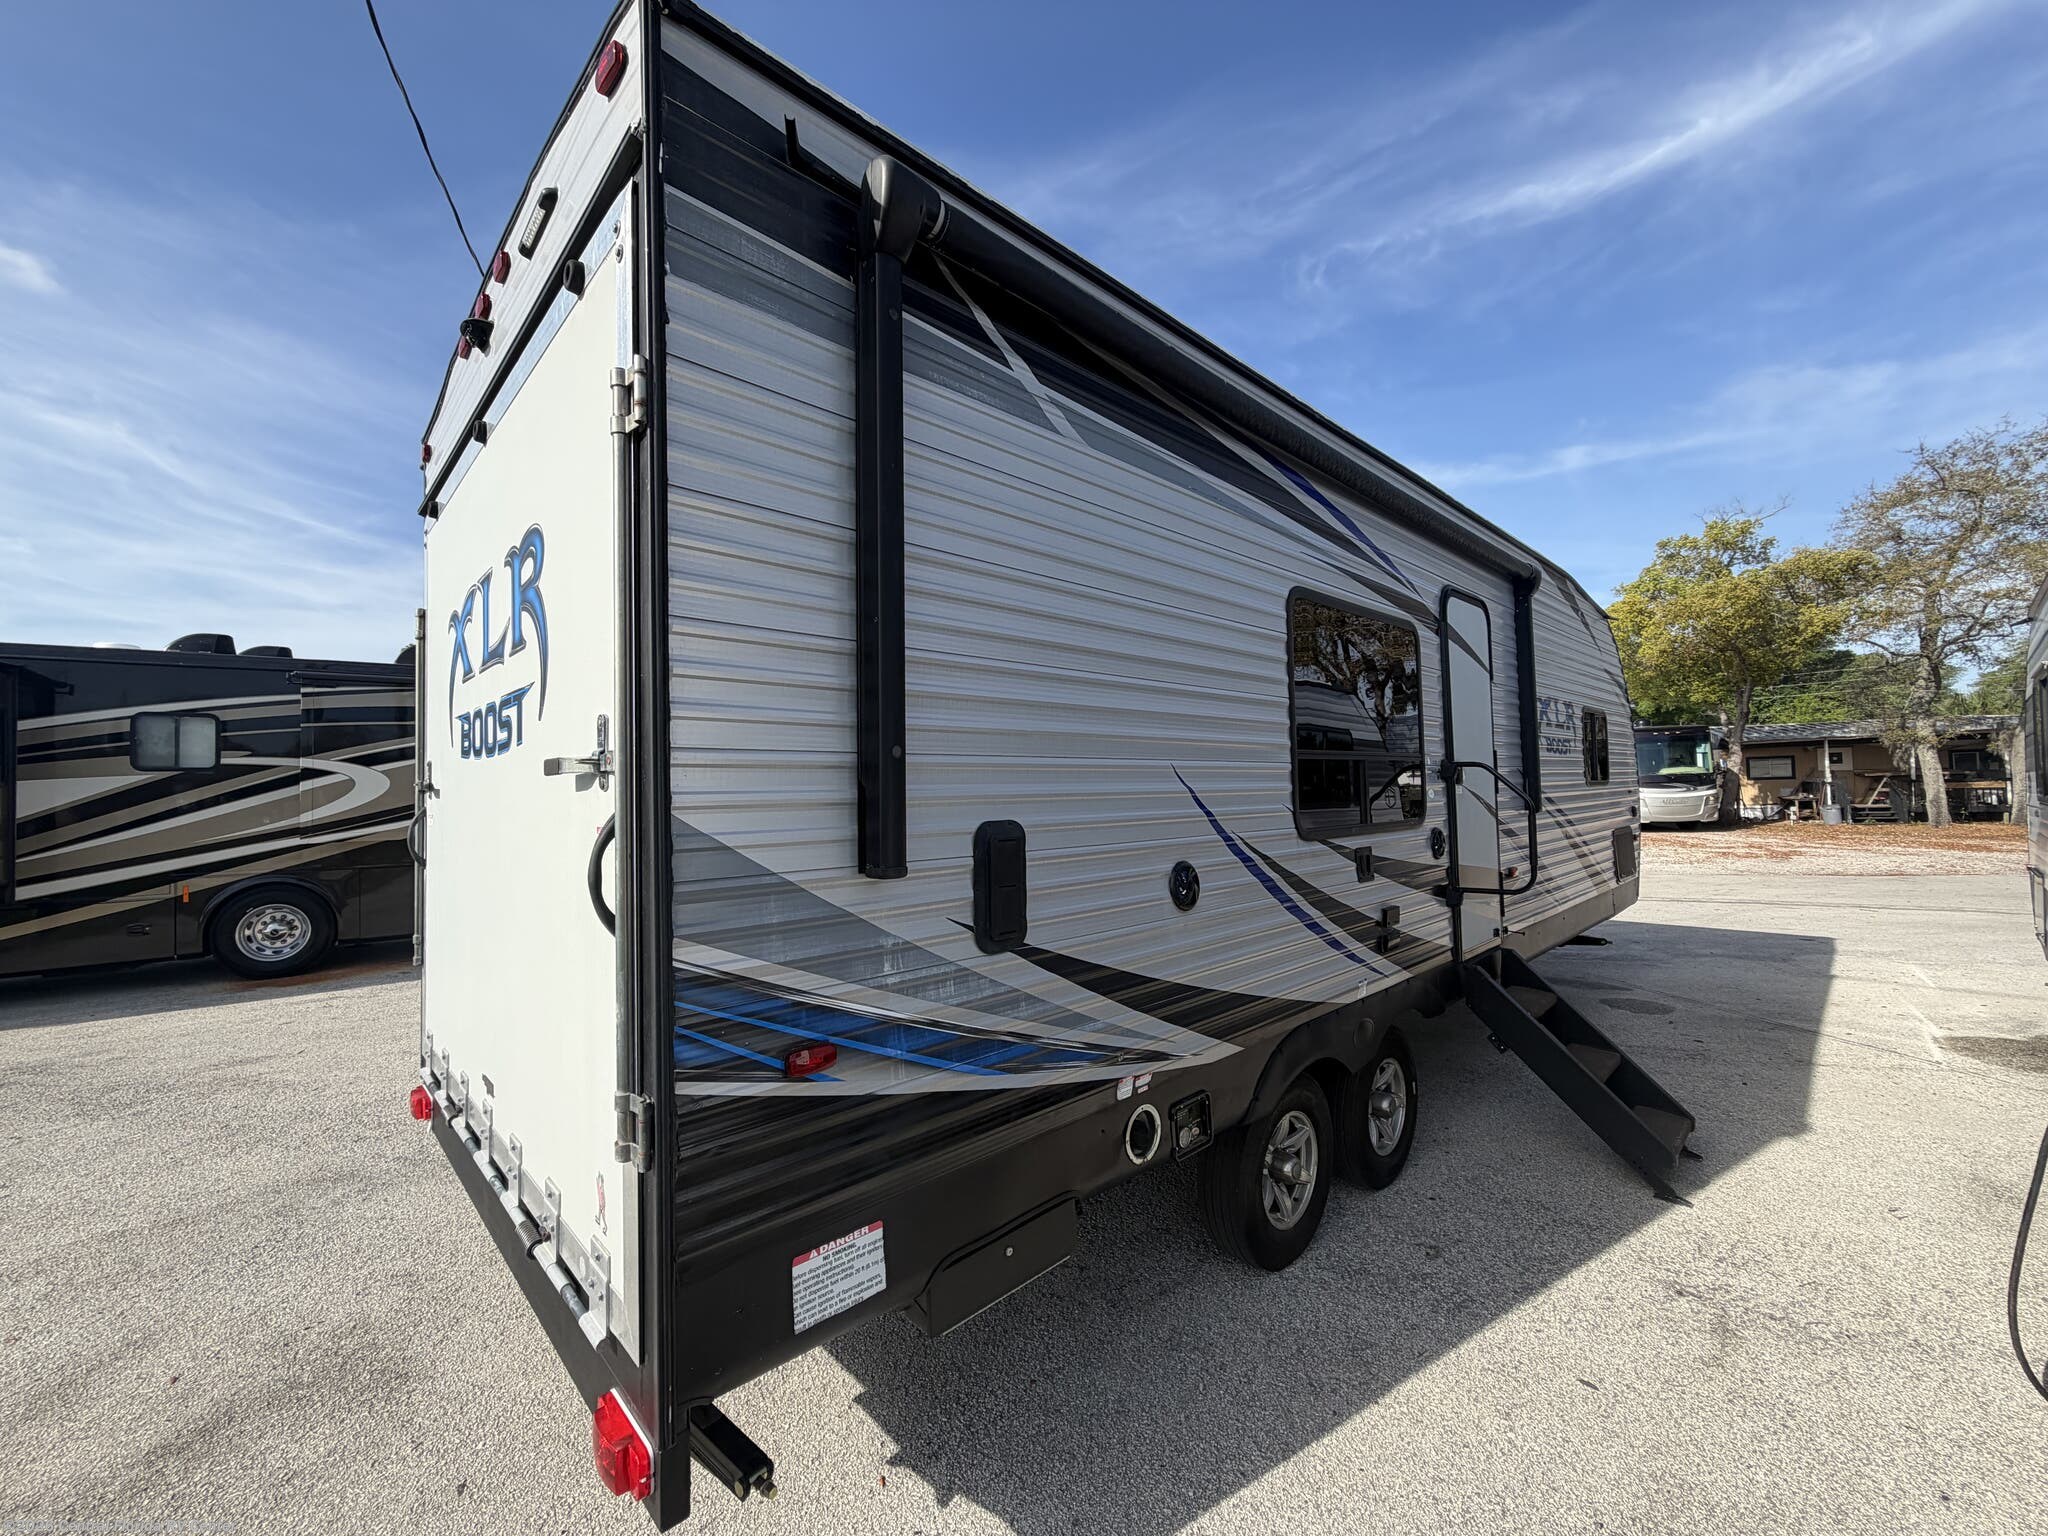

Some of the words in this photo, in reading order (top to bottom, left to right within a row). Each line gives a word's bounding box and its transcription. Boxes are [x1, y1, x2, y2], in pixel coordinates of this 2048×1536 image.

[448, 522, 549, 748] XLR
[455, 681, 536, 760] BOOST
[819, 1226, 869, 1254] DANGER
